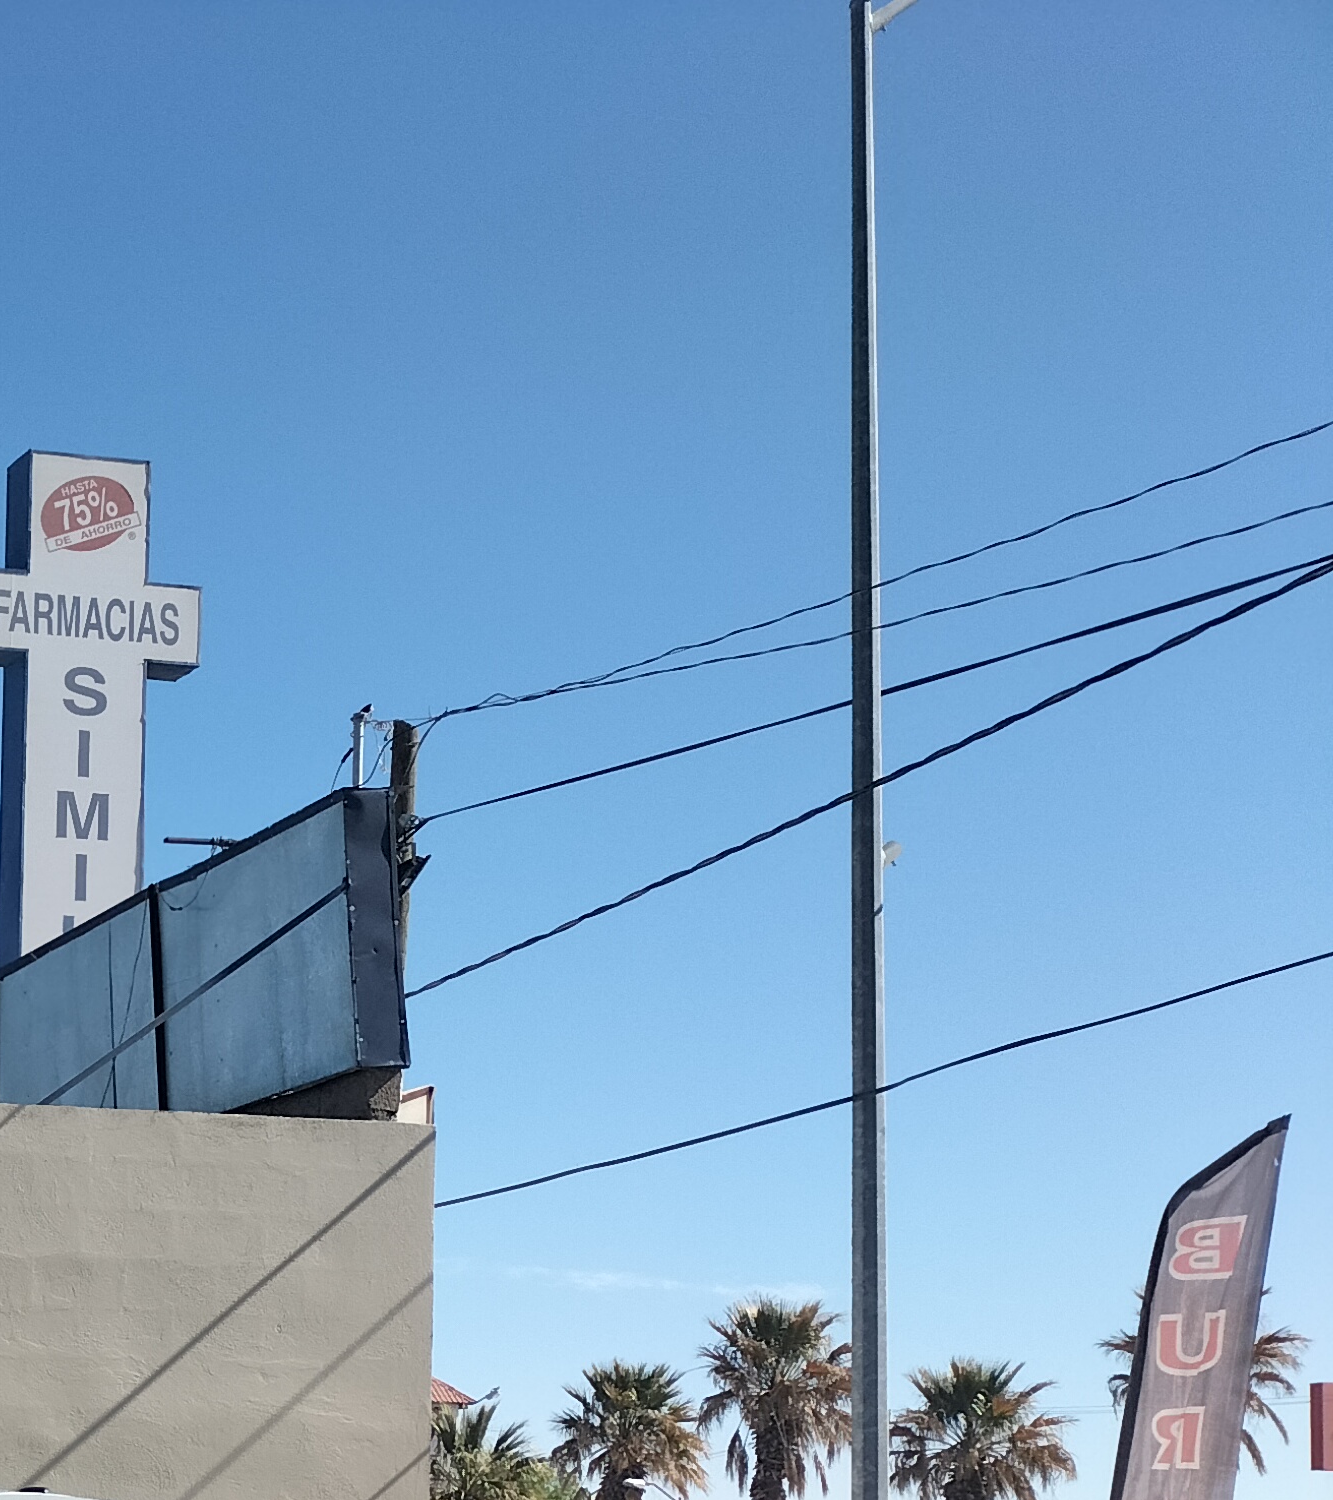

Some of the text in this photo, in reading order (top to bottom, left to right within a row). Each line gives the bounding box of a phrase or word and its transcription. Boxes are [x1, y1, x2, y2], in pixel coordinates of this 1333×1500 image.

[61, 479, 98, 497] HASTA
[53, 486, 118, 531] 75%
[54, 517, 132, 547] DE AHORRO
